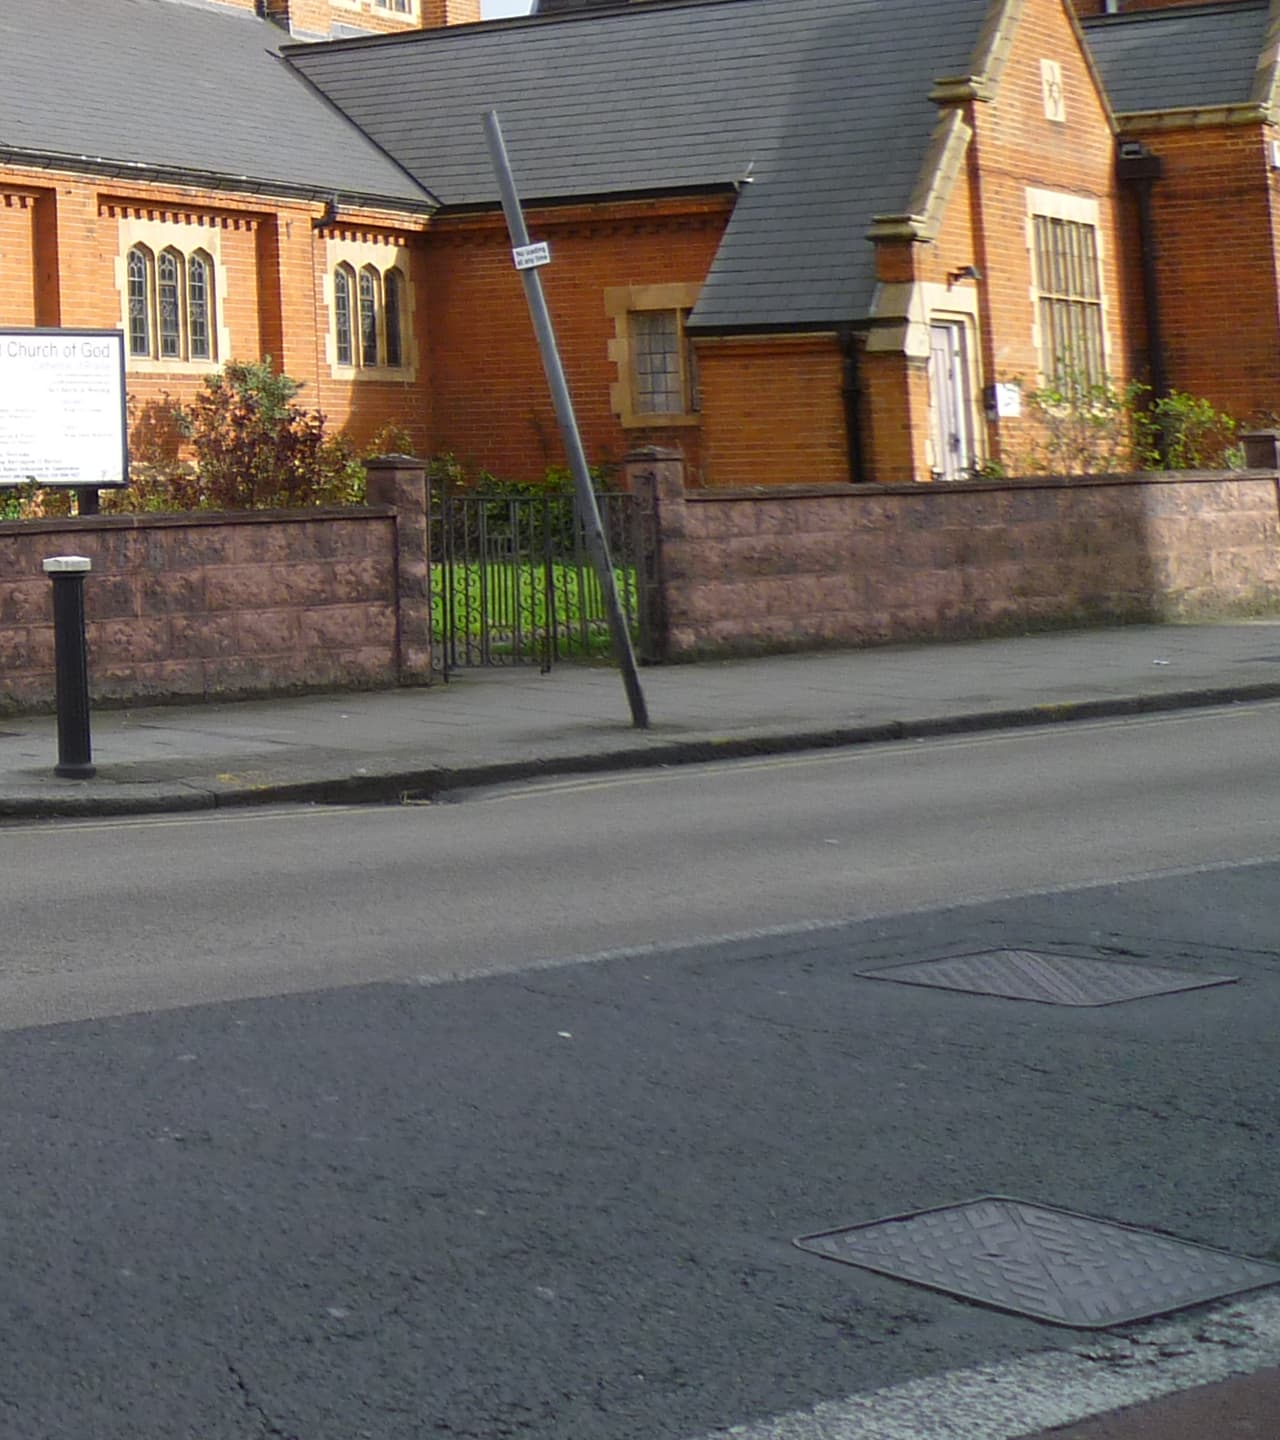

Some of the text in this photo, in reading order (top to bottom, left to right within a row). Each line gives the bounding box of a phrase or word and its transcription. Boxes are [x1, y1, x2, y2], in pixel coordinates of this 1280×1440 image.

[7, 341, 58, 358] Church
[63, 342, 76, 358] of
[81, 342, 110, 358] God
